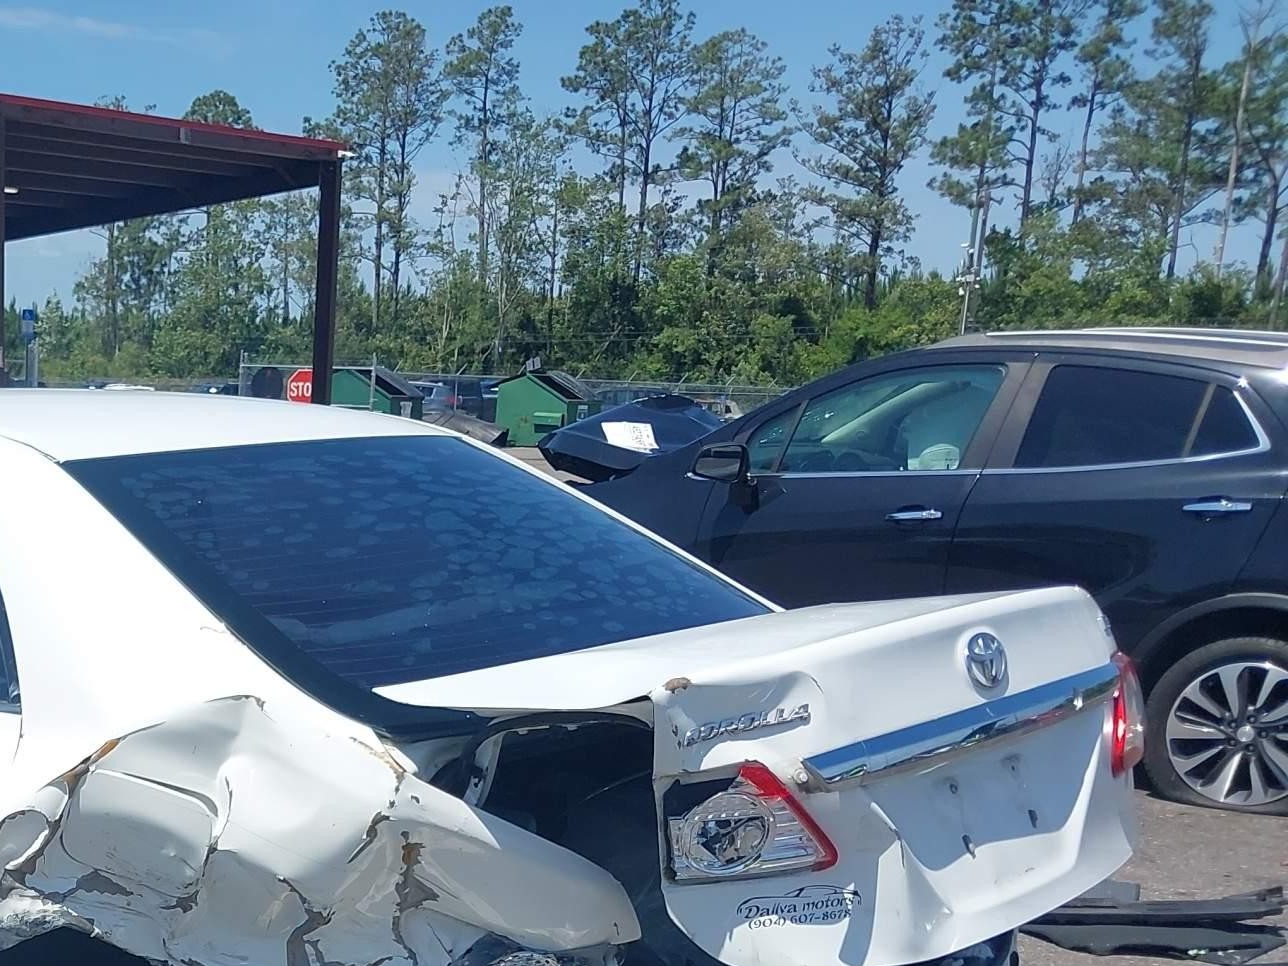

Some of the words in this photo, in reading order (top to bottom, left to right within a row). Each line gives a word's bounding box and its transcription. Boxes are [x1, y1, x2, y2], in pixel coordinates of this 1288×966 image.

[290, 382, 312, 397] STO
[683, 703, 811, 747] COROLLA
[802, 896, 854, 912] motors
[748, 916, 787, 930] (904)
[790, 908, 852, 924] 607-8678
